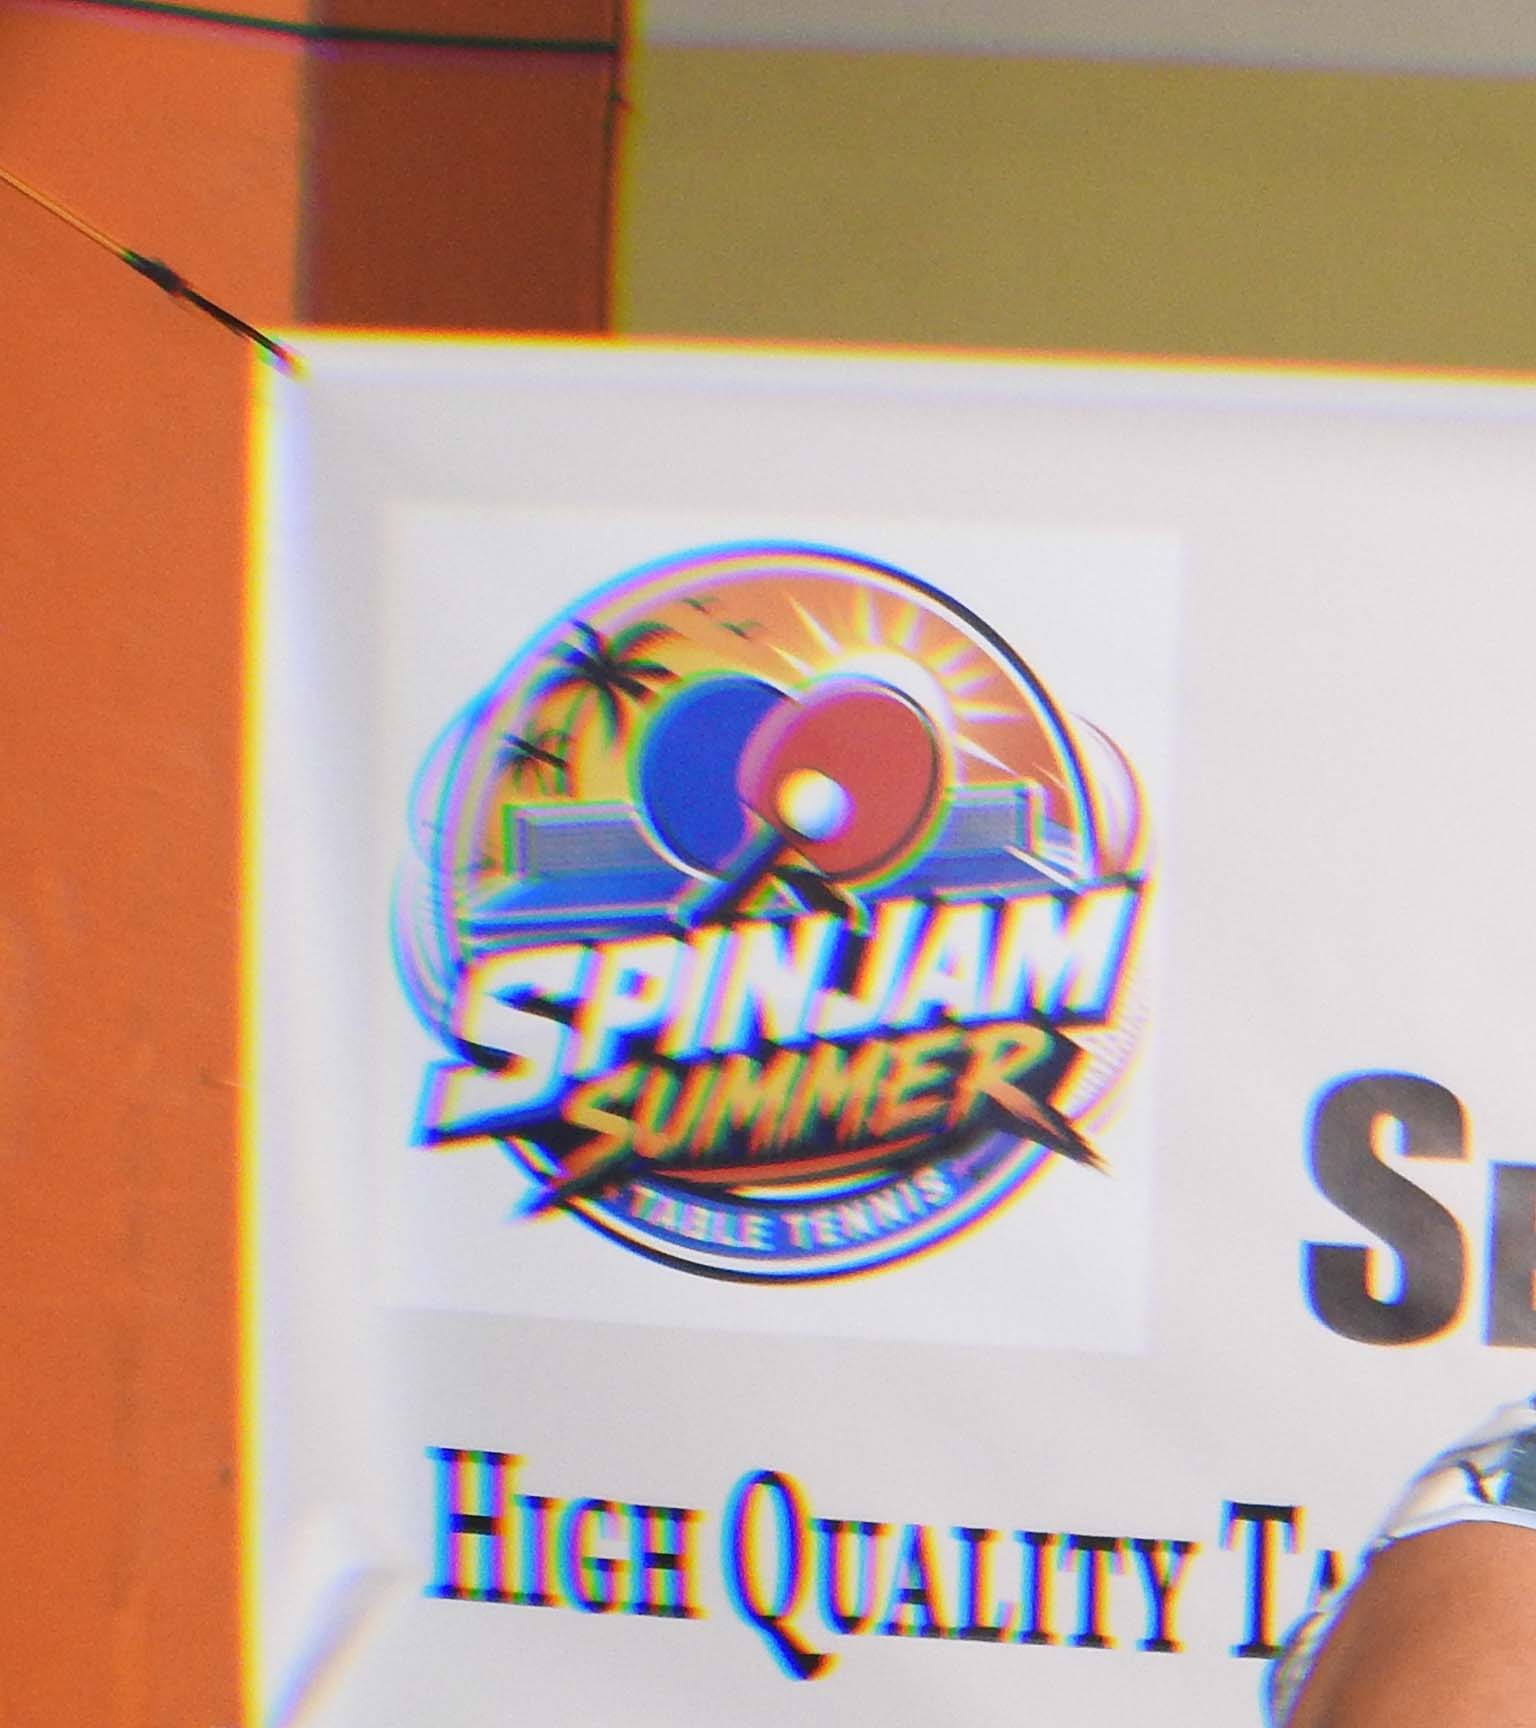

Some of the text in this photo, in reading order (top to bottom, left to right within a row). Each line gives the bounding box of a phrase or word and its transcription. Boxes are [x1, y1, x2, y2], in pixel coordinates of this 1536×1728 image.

[418, 886, 1142, 1138] SPINJAM
[544, 1022, 1085, 1186] SUMMER
[631, 1165, 955, 1251] TABLE TENNIS
[425, 1446, 707, 1620] HIGH
[721, 1468, 1200, 1681] QUALITY
